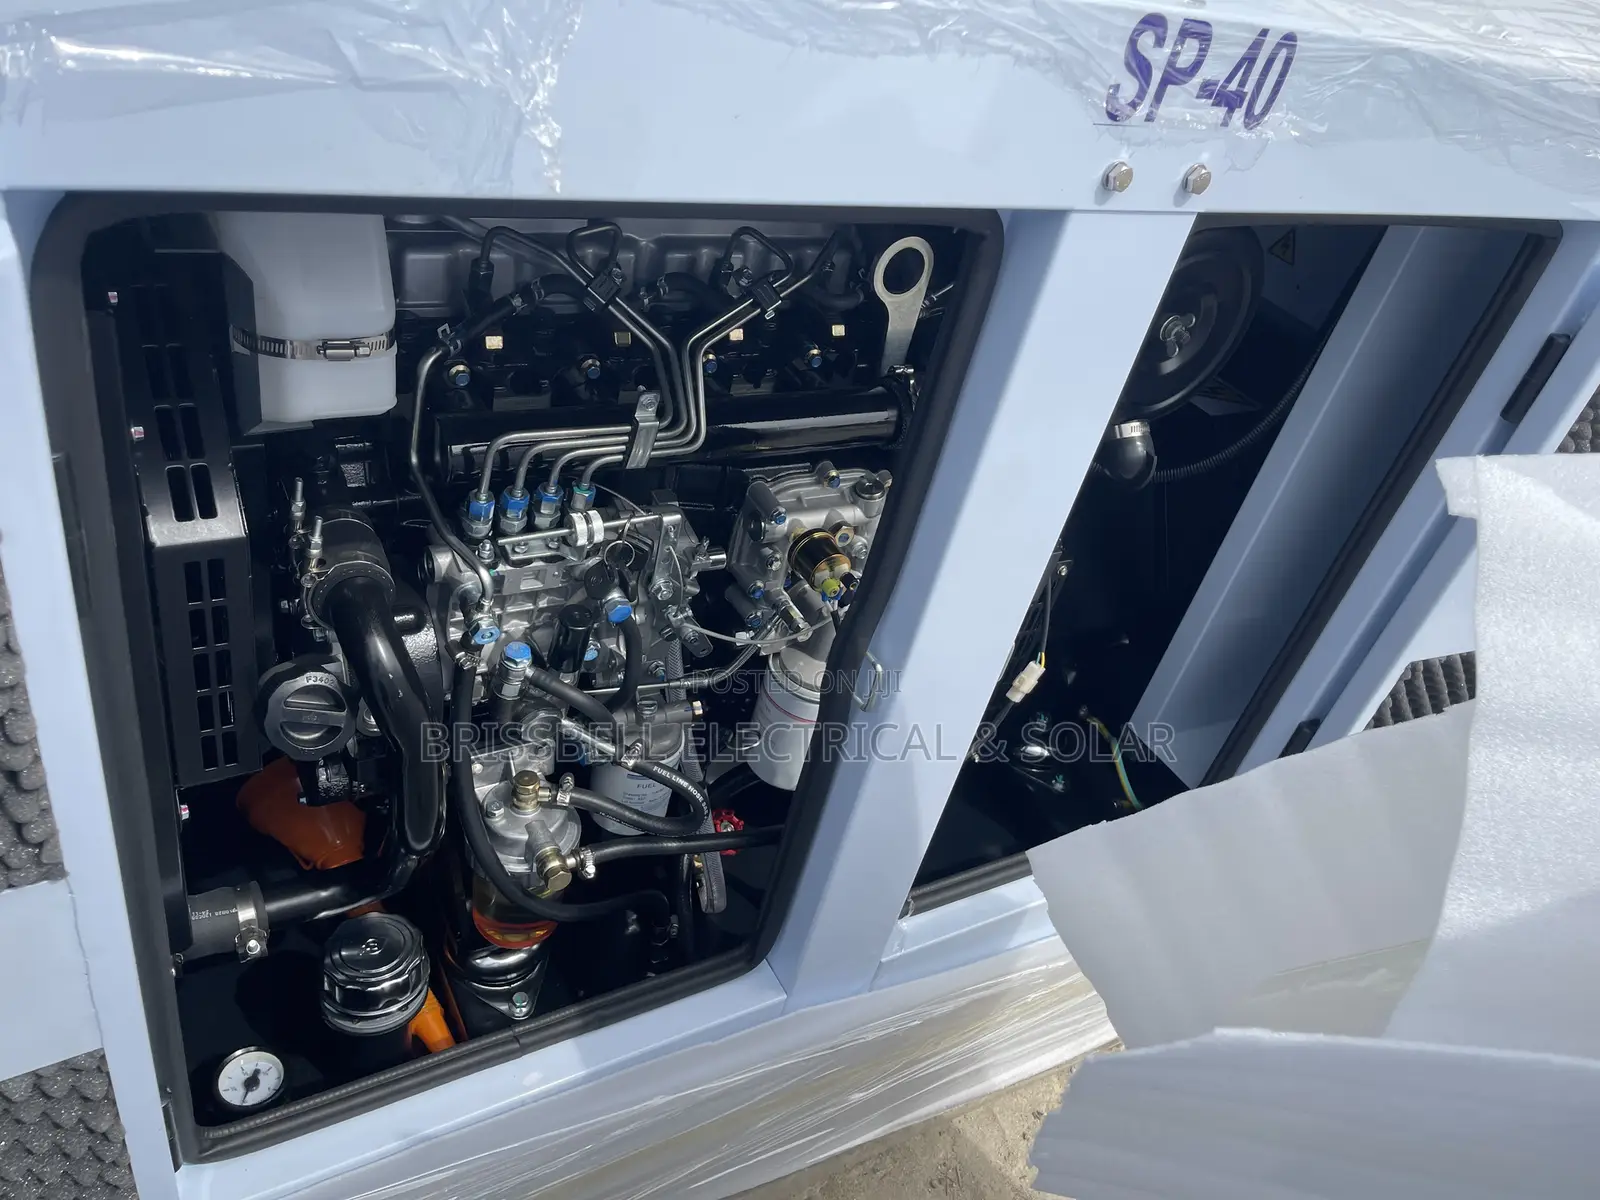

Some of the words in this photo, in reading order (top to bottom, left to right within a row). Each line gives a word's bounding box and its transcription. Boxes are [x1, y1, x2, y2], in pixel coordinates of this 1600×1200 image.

[1105, 12, 1298, 130] SP-40
[653, 765, 671, 779] FUEL
[671, 774, 690, 788] LINE
[687, 785, 705, 803] HOSE
